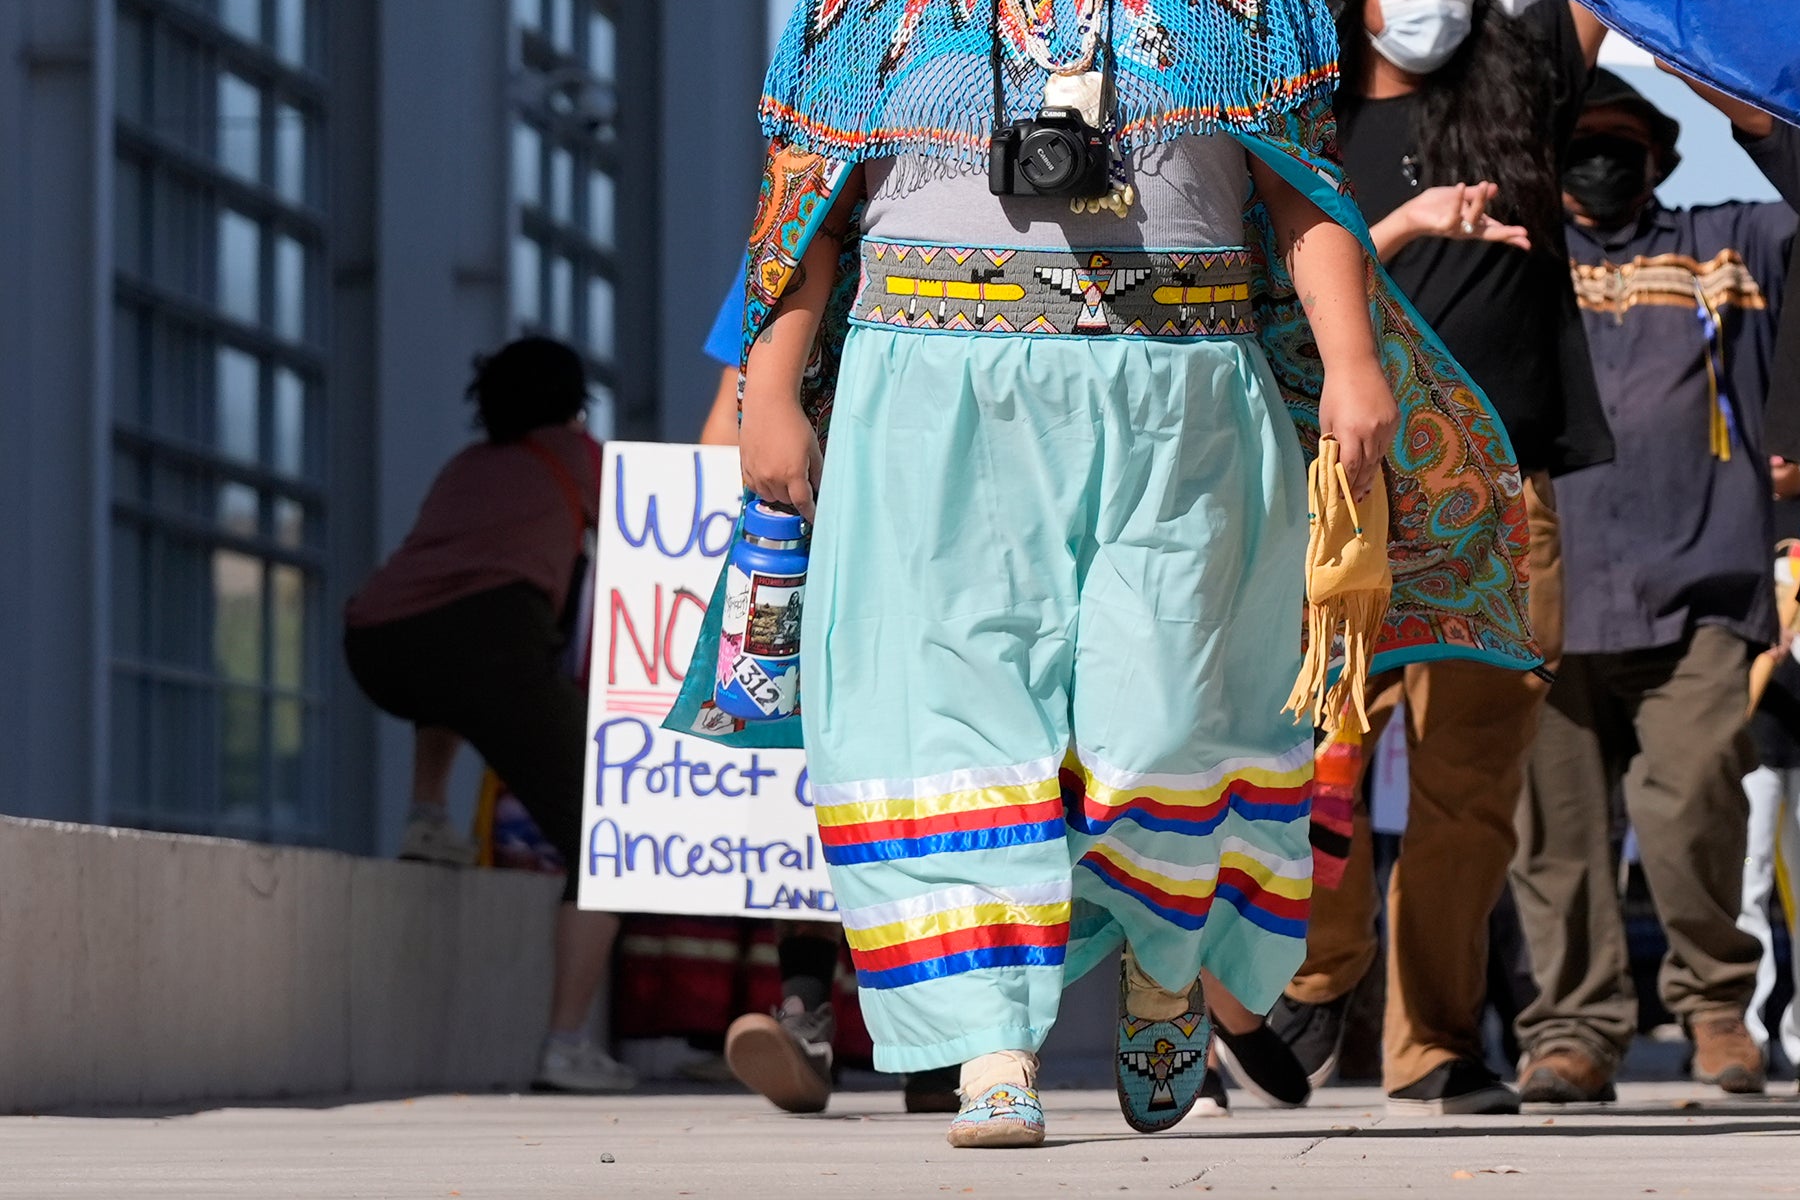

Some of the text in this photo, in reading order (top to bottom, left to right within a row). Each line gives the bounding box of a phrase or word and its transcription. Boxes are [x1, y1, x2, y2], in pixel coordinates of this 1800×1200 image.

[1041, 110, 1067, 118] Canon
[1036, 148, 1055, 171] Canon
[615, 451, 743, 558] Wa
[732, 655, 780, 708] 1312
[593, 716, 777, 807] Protect
[589, 818, 814, 878] Ancestral
[744, 879, 839, 912] LAND
